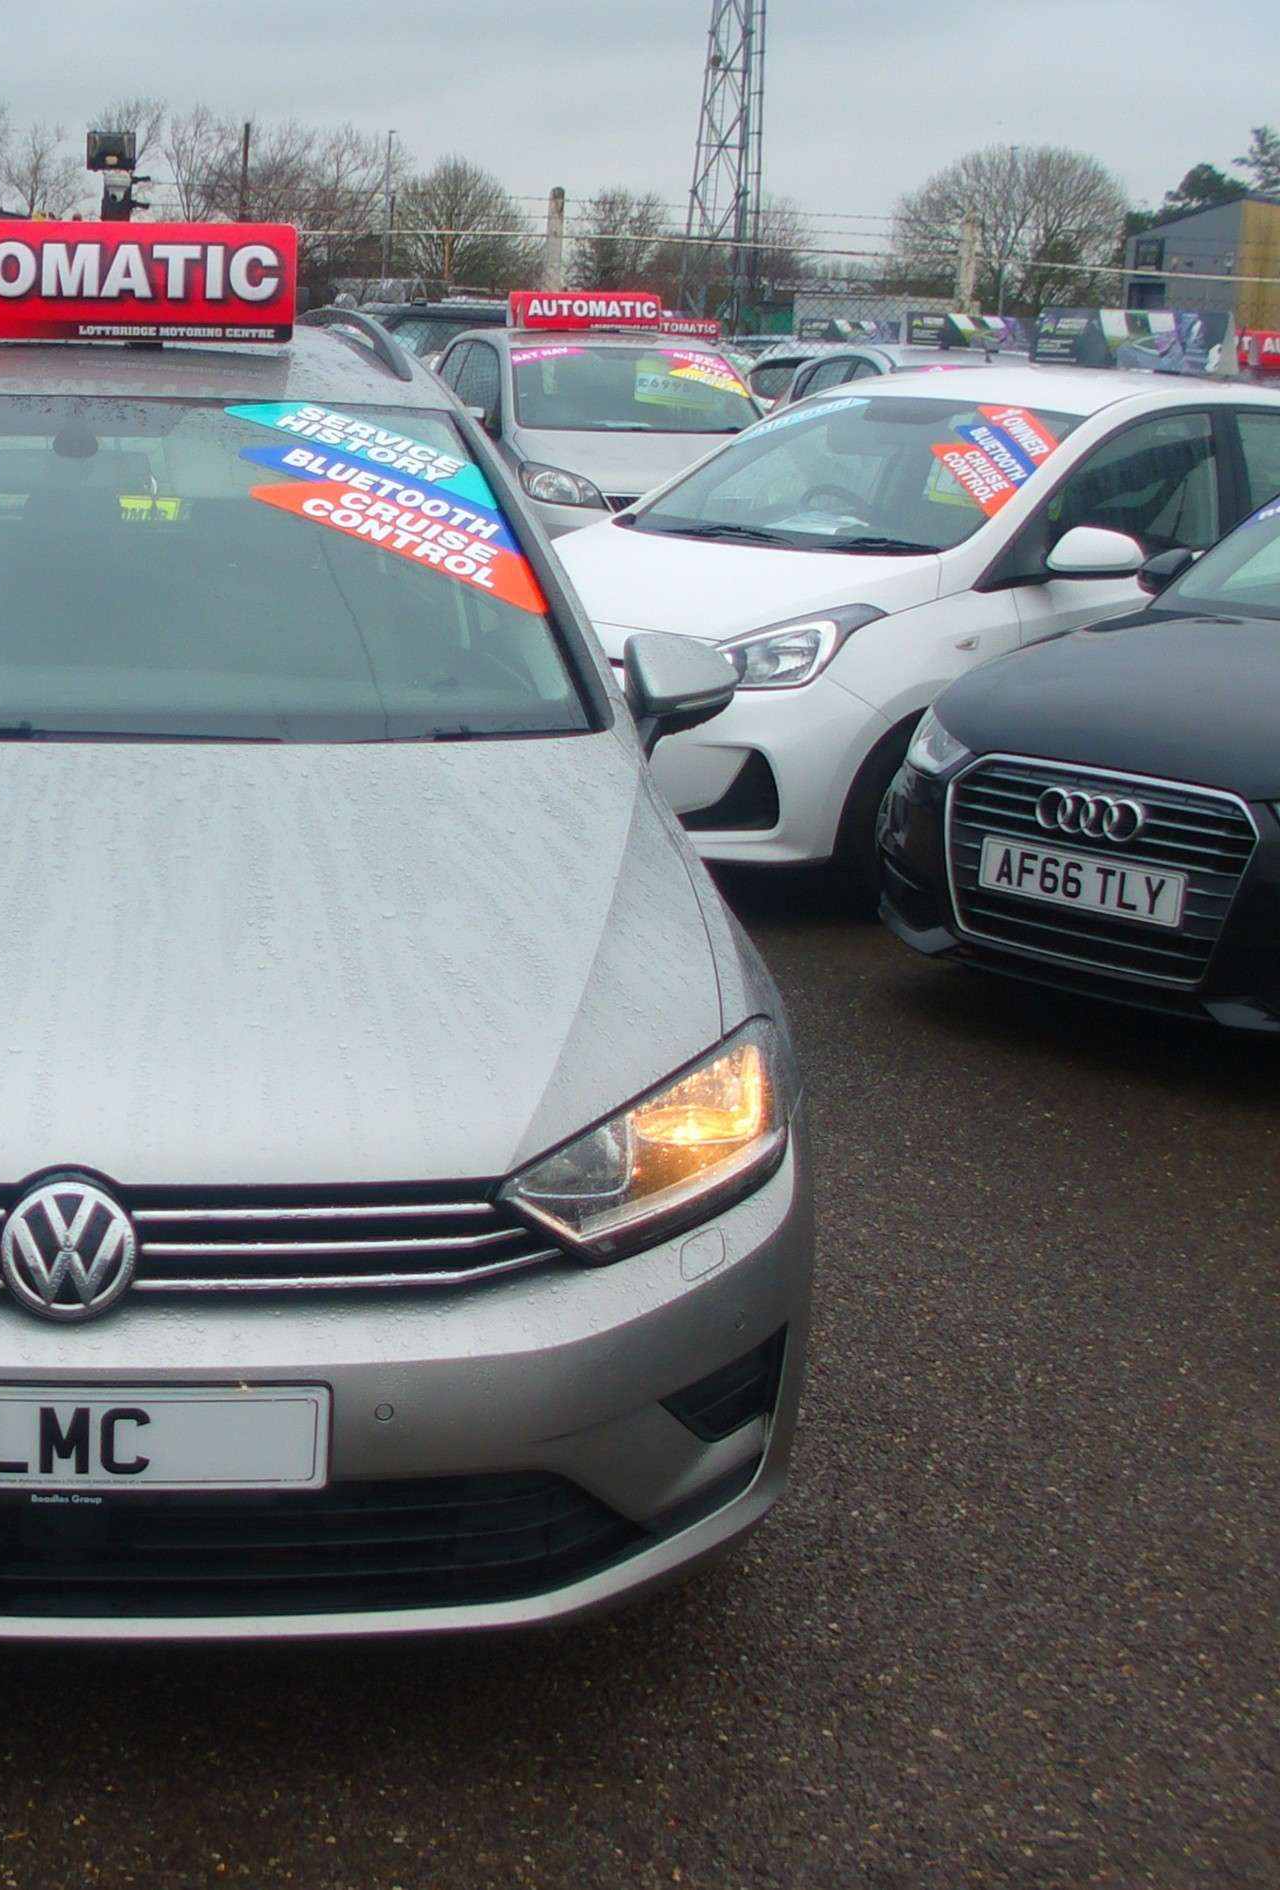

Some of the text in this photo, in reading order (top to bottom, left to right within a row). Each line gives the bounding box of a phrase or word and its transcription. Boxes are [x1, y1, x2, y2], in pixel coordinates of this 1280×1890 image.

[79, 325, 275, 338] LOTTBRIDGE MOTORING CENTRE
[528, 299, 657, 318] AUTOMATIC
[659, 322, 717, 334] TOMATIC
[277, 416, 452, 482] HISTORY
[296, 406, 466, 474] SERVICE
[969, 426, 1028, 481] BLUETOOTH
[1003, 417, 1049, 456] OWNER
[282, 448, 499, 539] BLUETOOTH
[943, 452, 995, 504] CONTROL
[964, 450, 1009, 492] CRUISE
[302, 498, 495, 588] CONTROL
[340, 492, 499, 564] CRUISE
[995, 848, 1166, 915] AF66 TLY
[72, 1494, 102, 1504] Group
